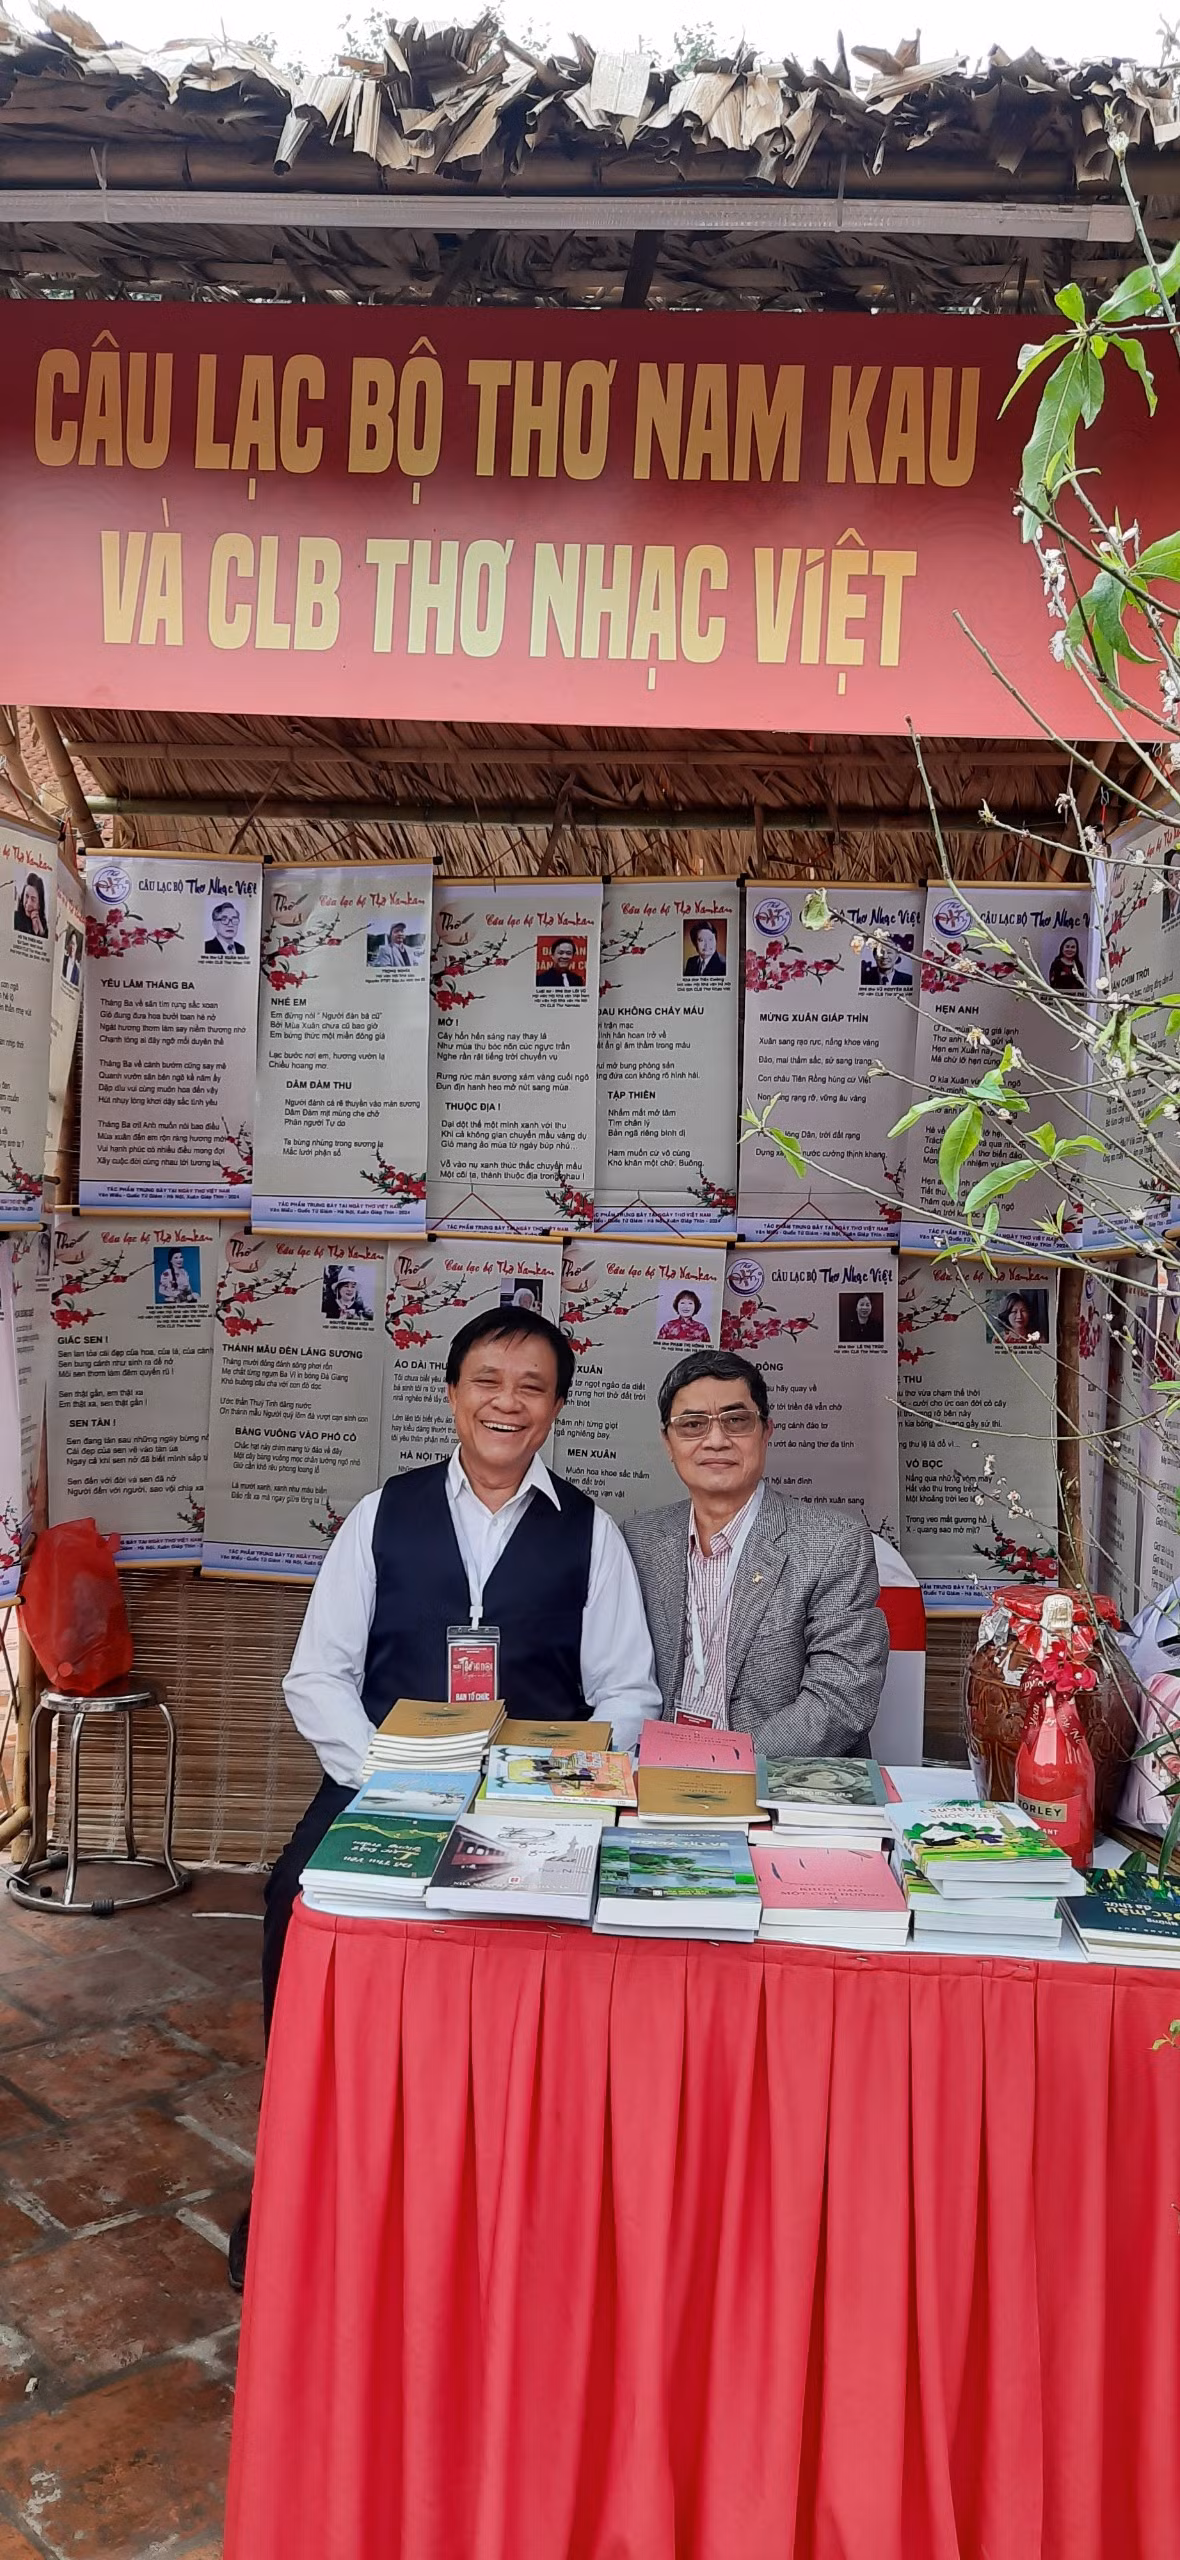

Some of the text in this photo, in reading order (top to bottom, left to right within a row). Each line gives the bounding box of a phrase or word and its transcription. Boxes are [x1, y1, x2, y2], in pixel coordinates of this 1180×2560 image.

[35, 330, 980, 504] CÂU LẠC BỘ THƠ NAM KAU
[101, 498, 183, 646] VÀ
[209, 533, 341, 650] CLB
[366, 539, 514, 658] THƠ
[530, 543, 728, 690] NHẠC
[139, 878, 154, 892] CÂU
[157, 881, 171, 894] LẠC
[173, 879, 183, 893] BỘ
[181, 982, 195, 990] BA
[618, 1006, 652, 1015] KHÔNG
[935, 1005, 979, 1014] HẸN ANH
[792, 1012, 818, 1022] XUÂN
[772, 1269, 788, 1282] CÂU
[790, 1272, 806, 1284] LẠC
[807, 1270, 817, 1283] BỘ
[84, 1336, 102, 1344] SEN
[576, 1364, 603, 1374] XUÂN
[903, 1375, 922, 1383] THU
[69, 1419, 89, 1427] SEN
[264, 1429, 296, 1439] VUÔNG
[568, 1448, 617, 1459] MEN XUÂN
